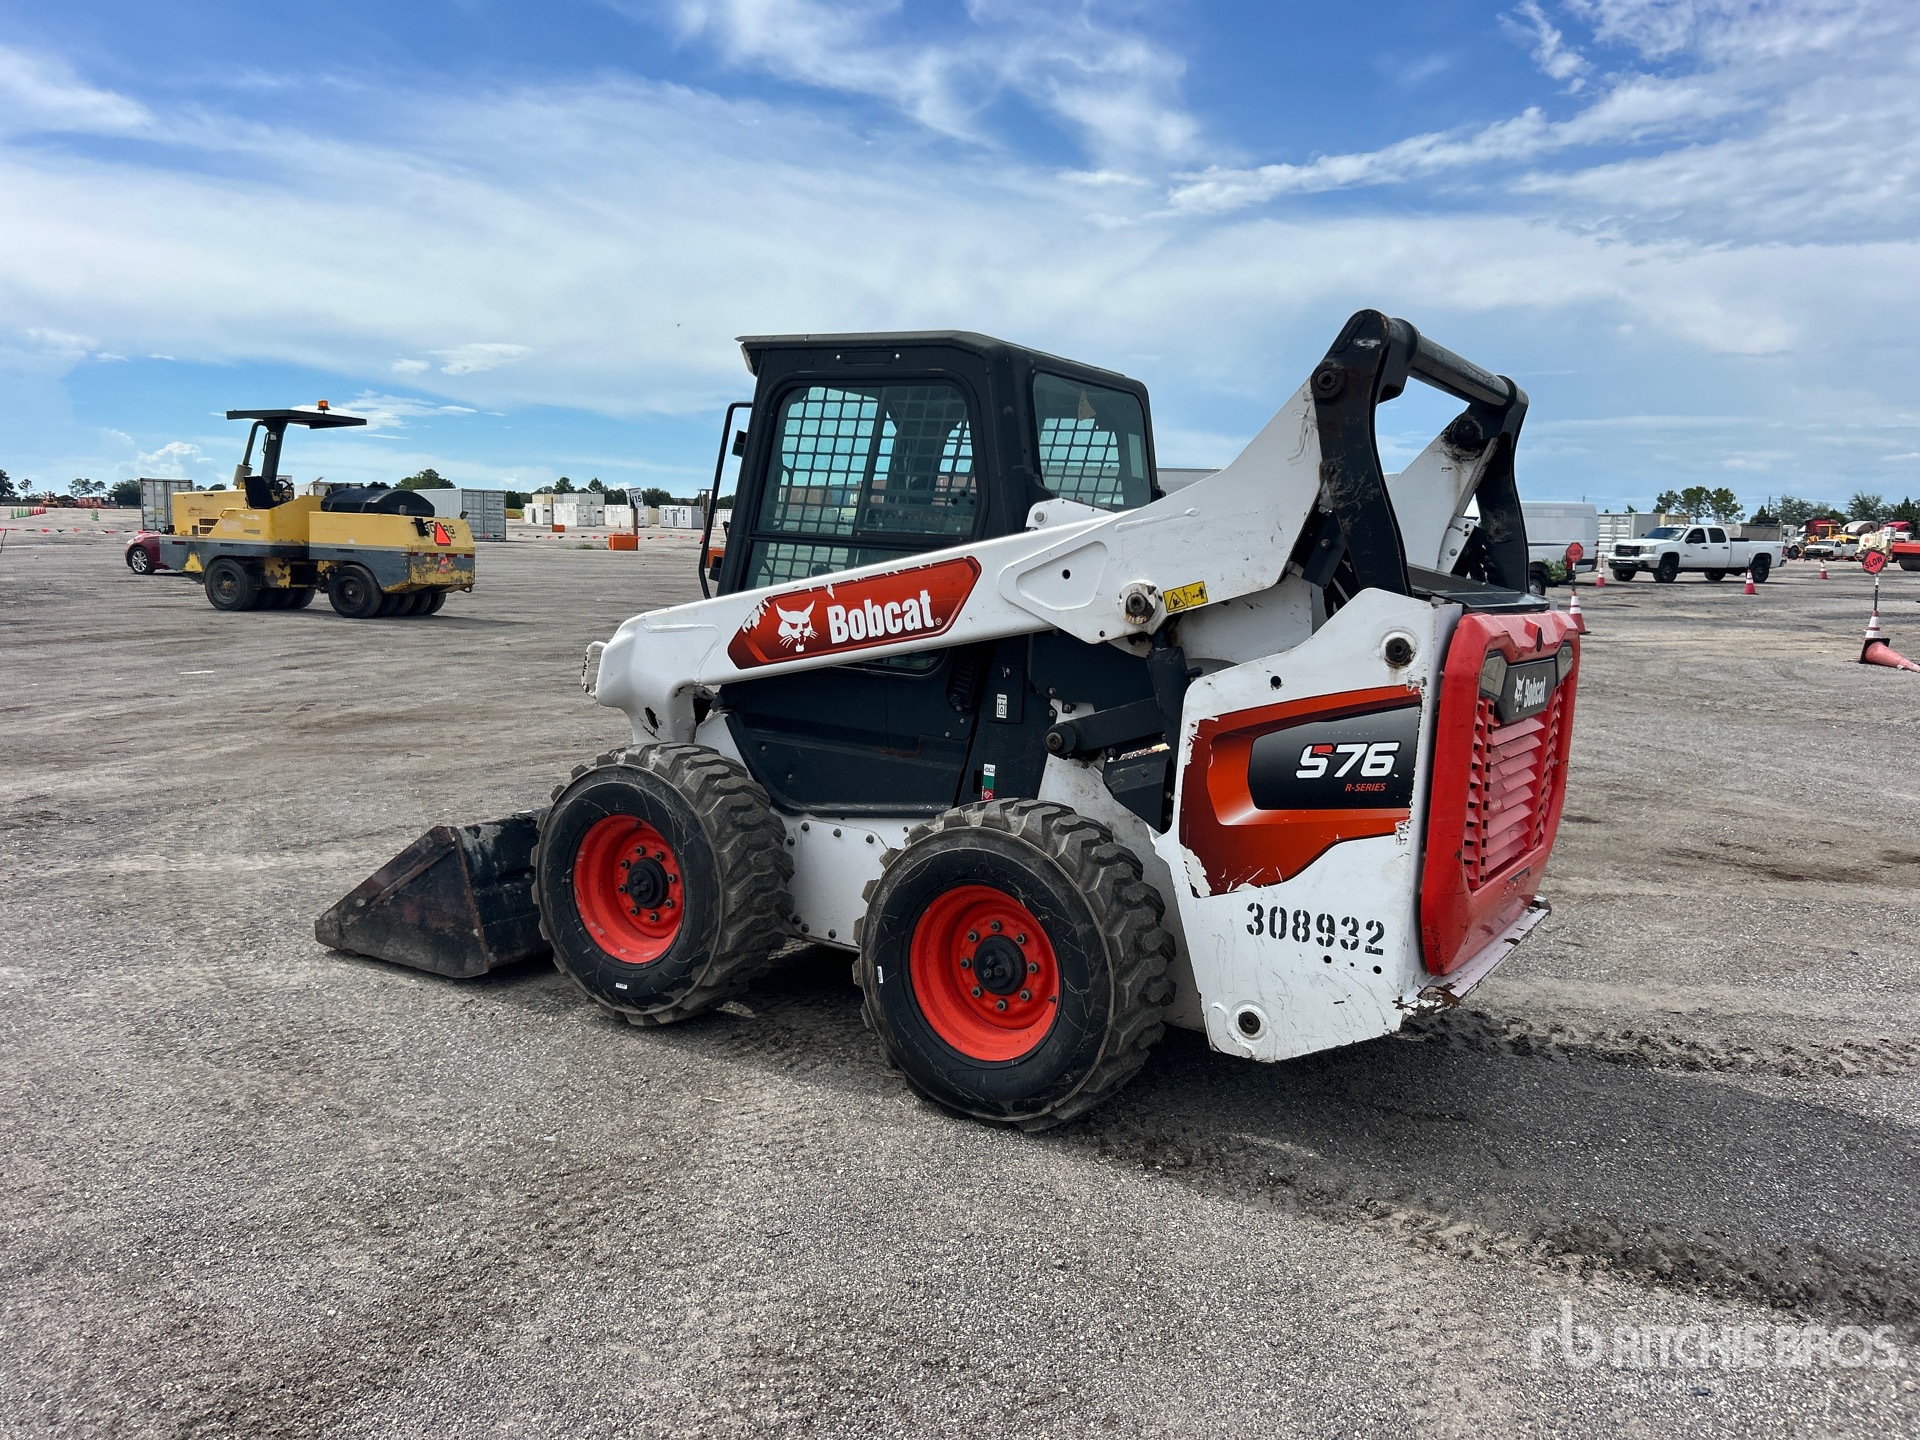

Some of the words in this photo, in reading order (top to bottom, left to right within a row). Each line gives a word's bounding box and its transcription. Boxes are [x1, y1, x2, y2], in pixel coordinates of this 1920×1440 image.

[1865, 556, 1883, 569] SLOW
[827, 590, 934, 644] Bobcat
[1523, 676, 1546, 708] Bobcat
[1296, 742, 1400, 779] S76
[1345, 782, 1387, 793] R-SERIES
[1246, 902, 1385, 956] 308932
